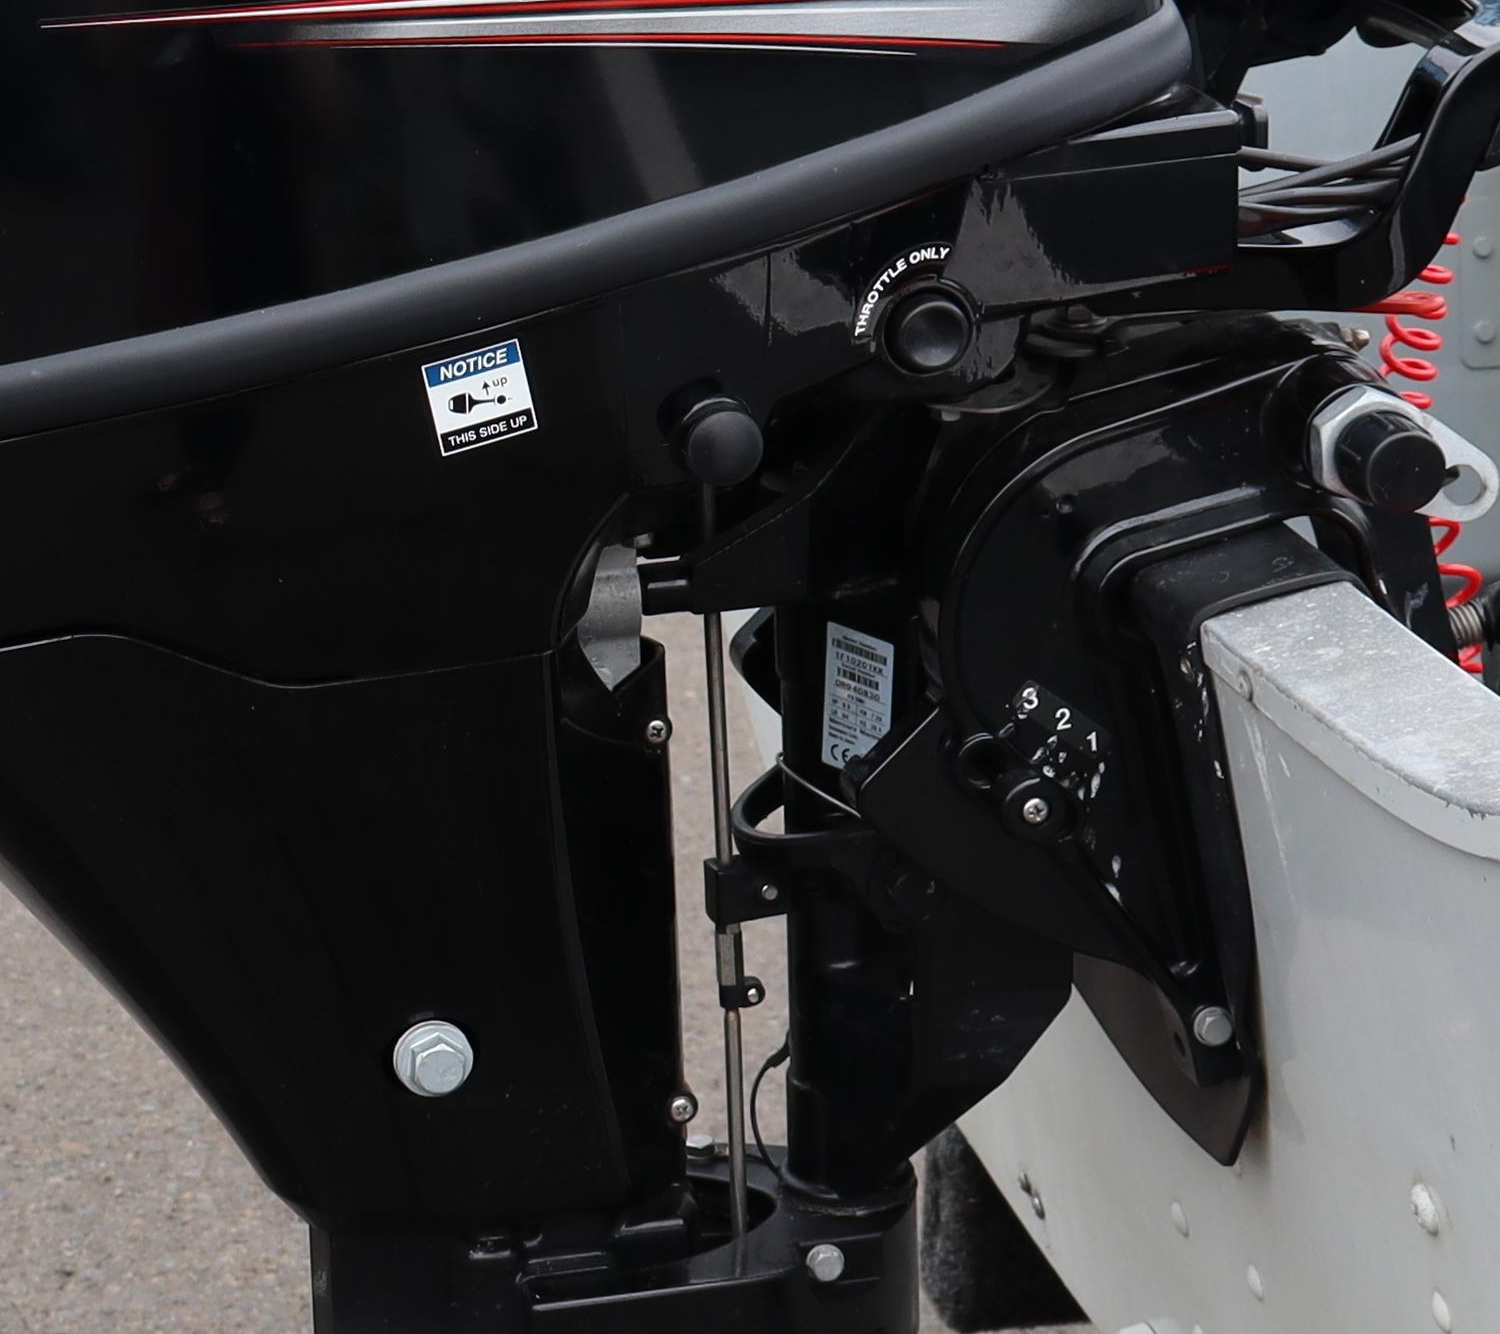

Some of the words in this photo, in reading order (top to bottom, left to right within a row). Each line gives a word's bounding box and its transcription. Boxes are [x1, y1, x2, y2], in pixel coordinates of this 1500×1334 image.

[854, 258, 907, 336] THROTTLE
[909, 247, 950, 264] ONLY
[440, 348, 508, 381] NOTICE
[448, 431, 477, 447] THIS
[479, 421, 507, 438] SIDE
[510, 415, 527, 428] UP
[1022, 687, 1039, 709] 3
[1055, 708, 1072, 730] 2
[1086, 731, 1097, 751] 1
